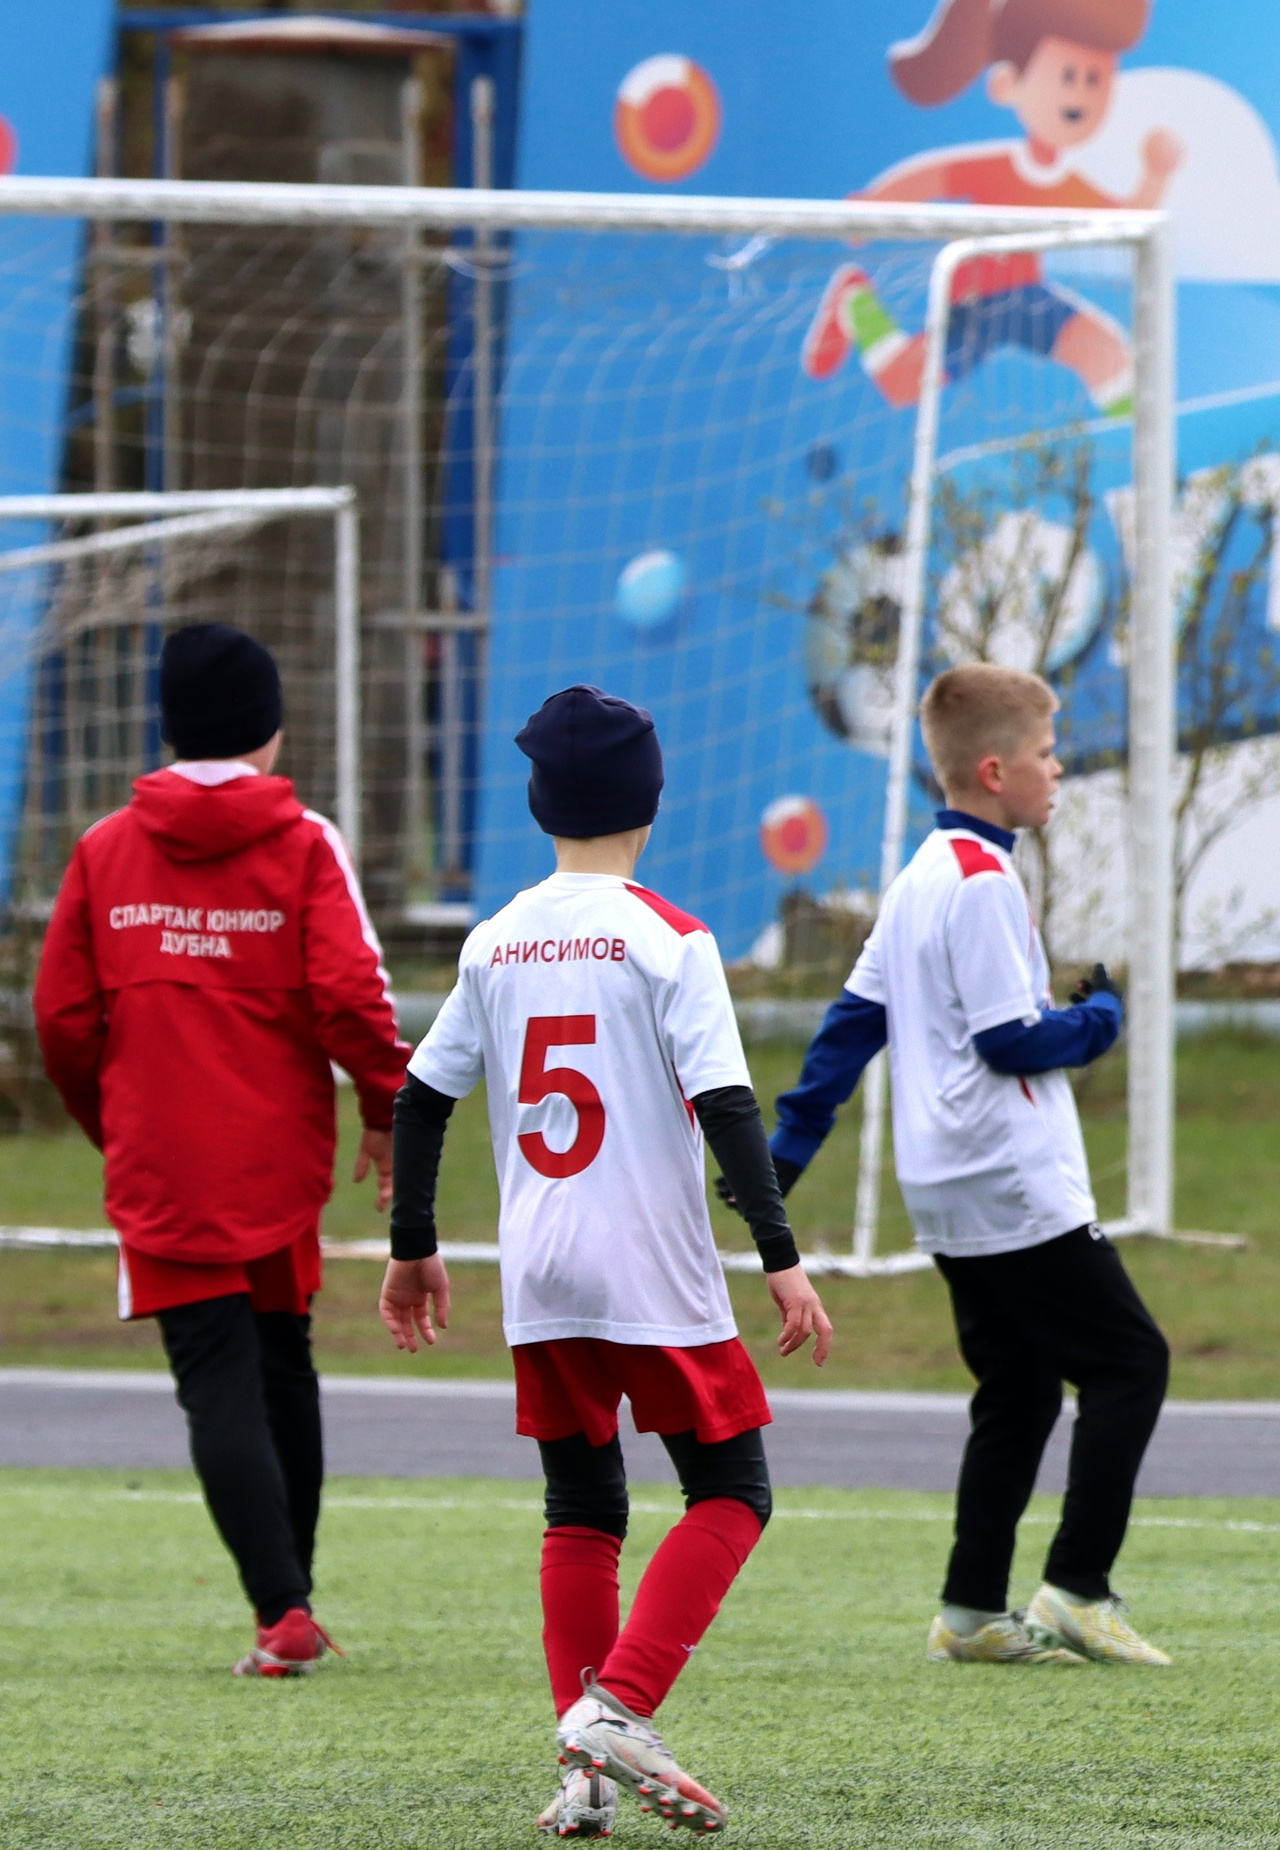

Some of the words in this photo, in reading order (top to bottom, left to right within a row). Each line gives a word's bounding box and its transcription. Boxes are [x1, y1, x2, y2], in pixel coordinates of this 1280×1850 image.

[109, 903, 203, 930] СПАРТАК
[206, 908, 285, 932] ЮНИОР
[159, 930, 233, 958] ДУБНА
[490, 937, 626, 969] АНИСИМОВ
[517, 1014, 605, 1178] 5
